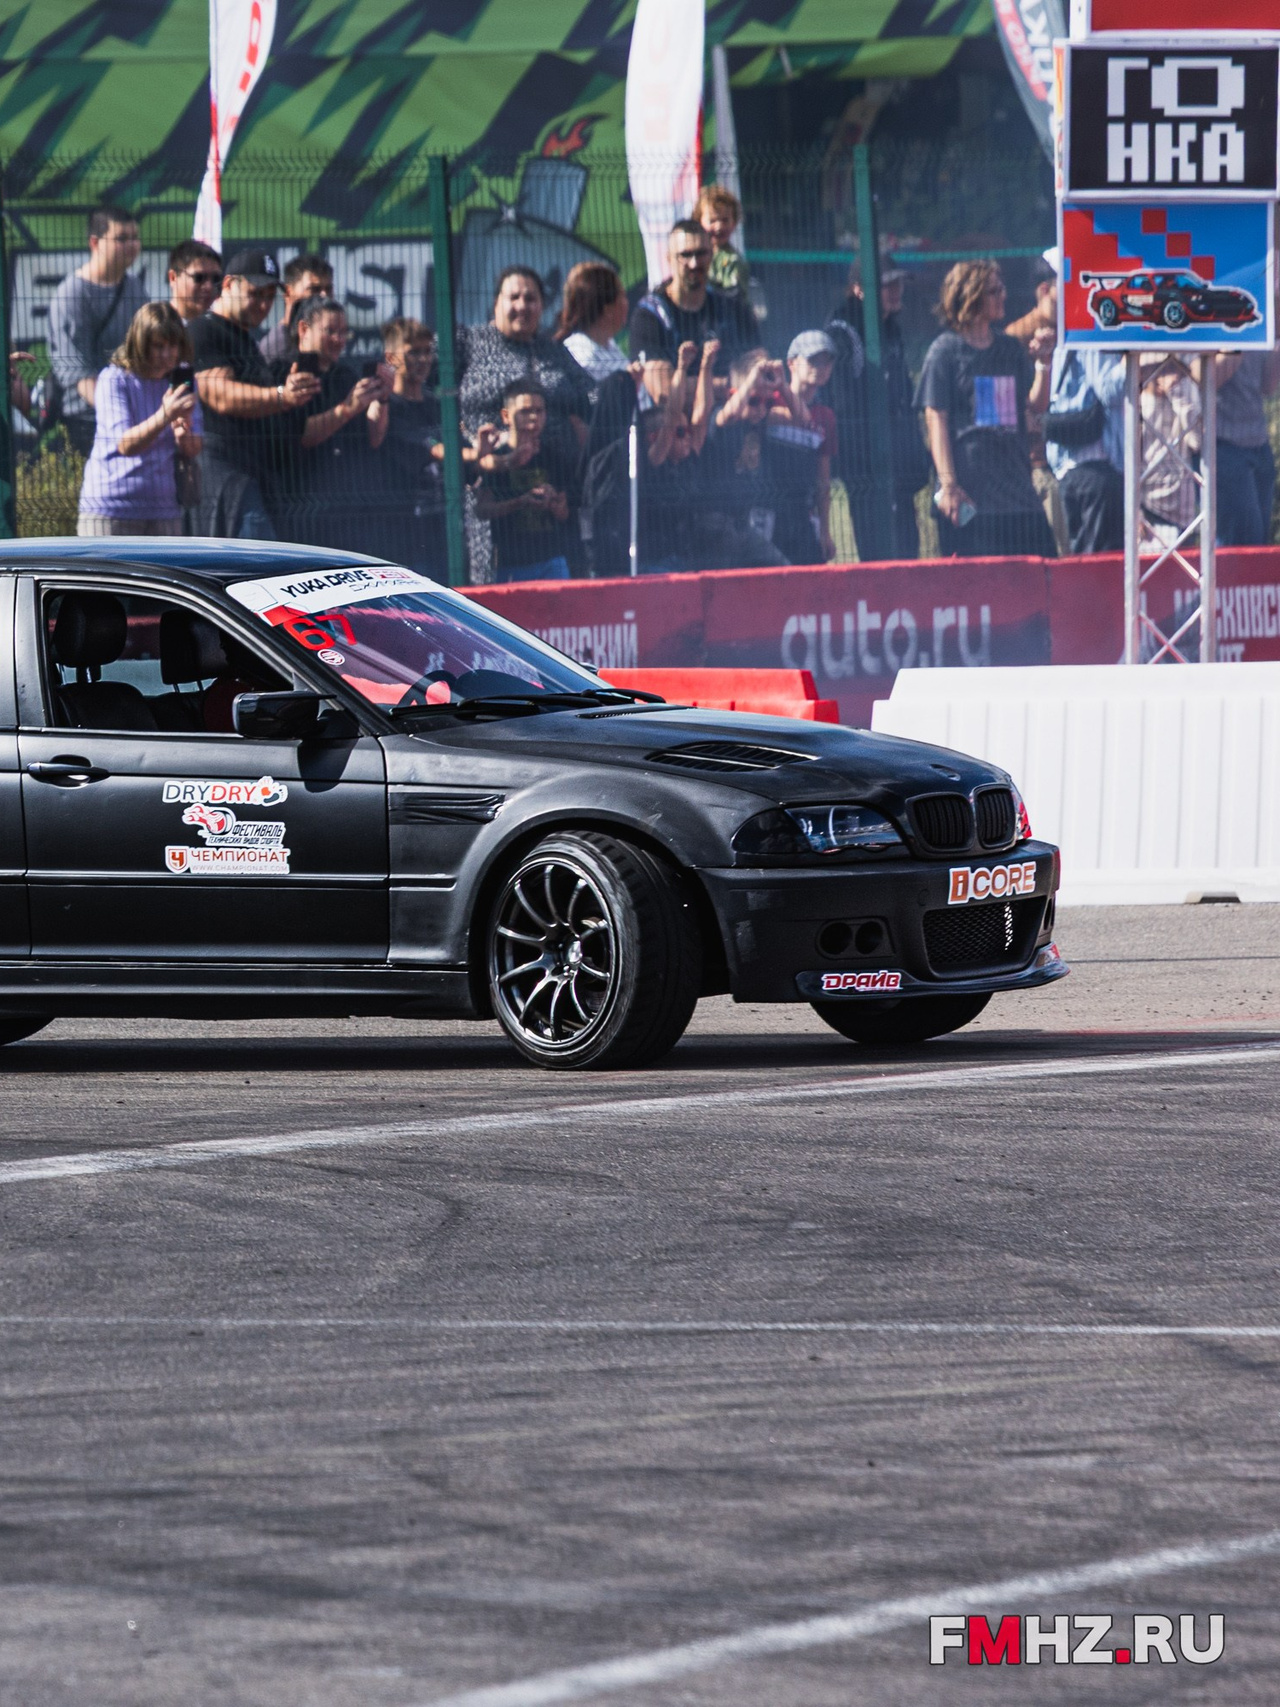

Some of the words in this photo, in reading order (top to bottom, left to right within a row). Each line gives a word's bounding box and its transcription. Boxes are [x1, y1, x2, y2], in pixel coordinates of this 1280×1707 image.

[1107, 57, 1245, 116] ГО
[1107, 123, 1245, 182] НКА
[280, 578, 331, 598] YUKA
[329, 570, 374, 590] DRIVE
[282, 613, 357, 651] 67
[781, 599, 991, 678] auto.ru
[166, 784, 257, 802] DRYDRY
[232, 823, 283, 837] ФЕСТИВАЛЬ
[191, 850, 288, 862] ЧЕМПИОНАТ
[191, 864, 288, 872] WWW.CHAMPIONAT.COM
